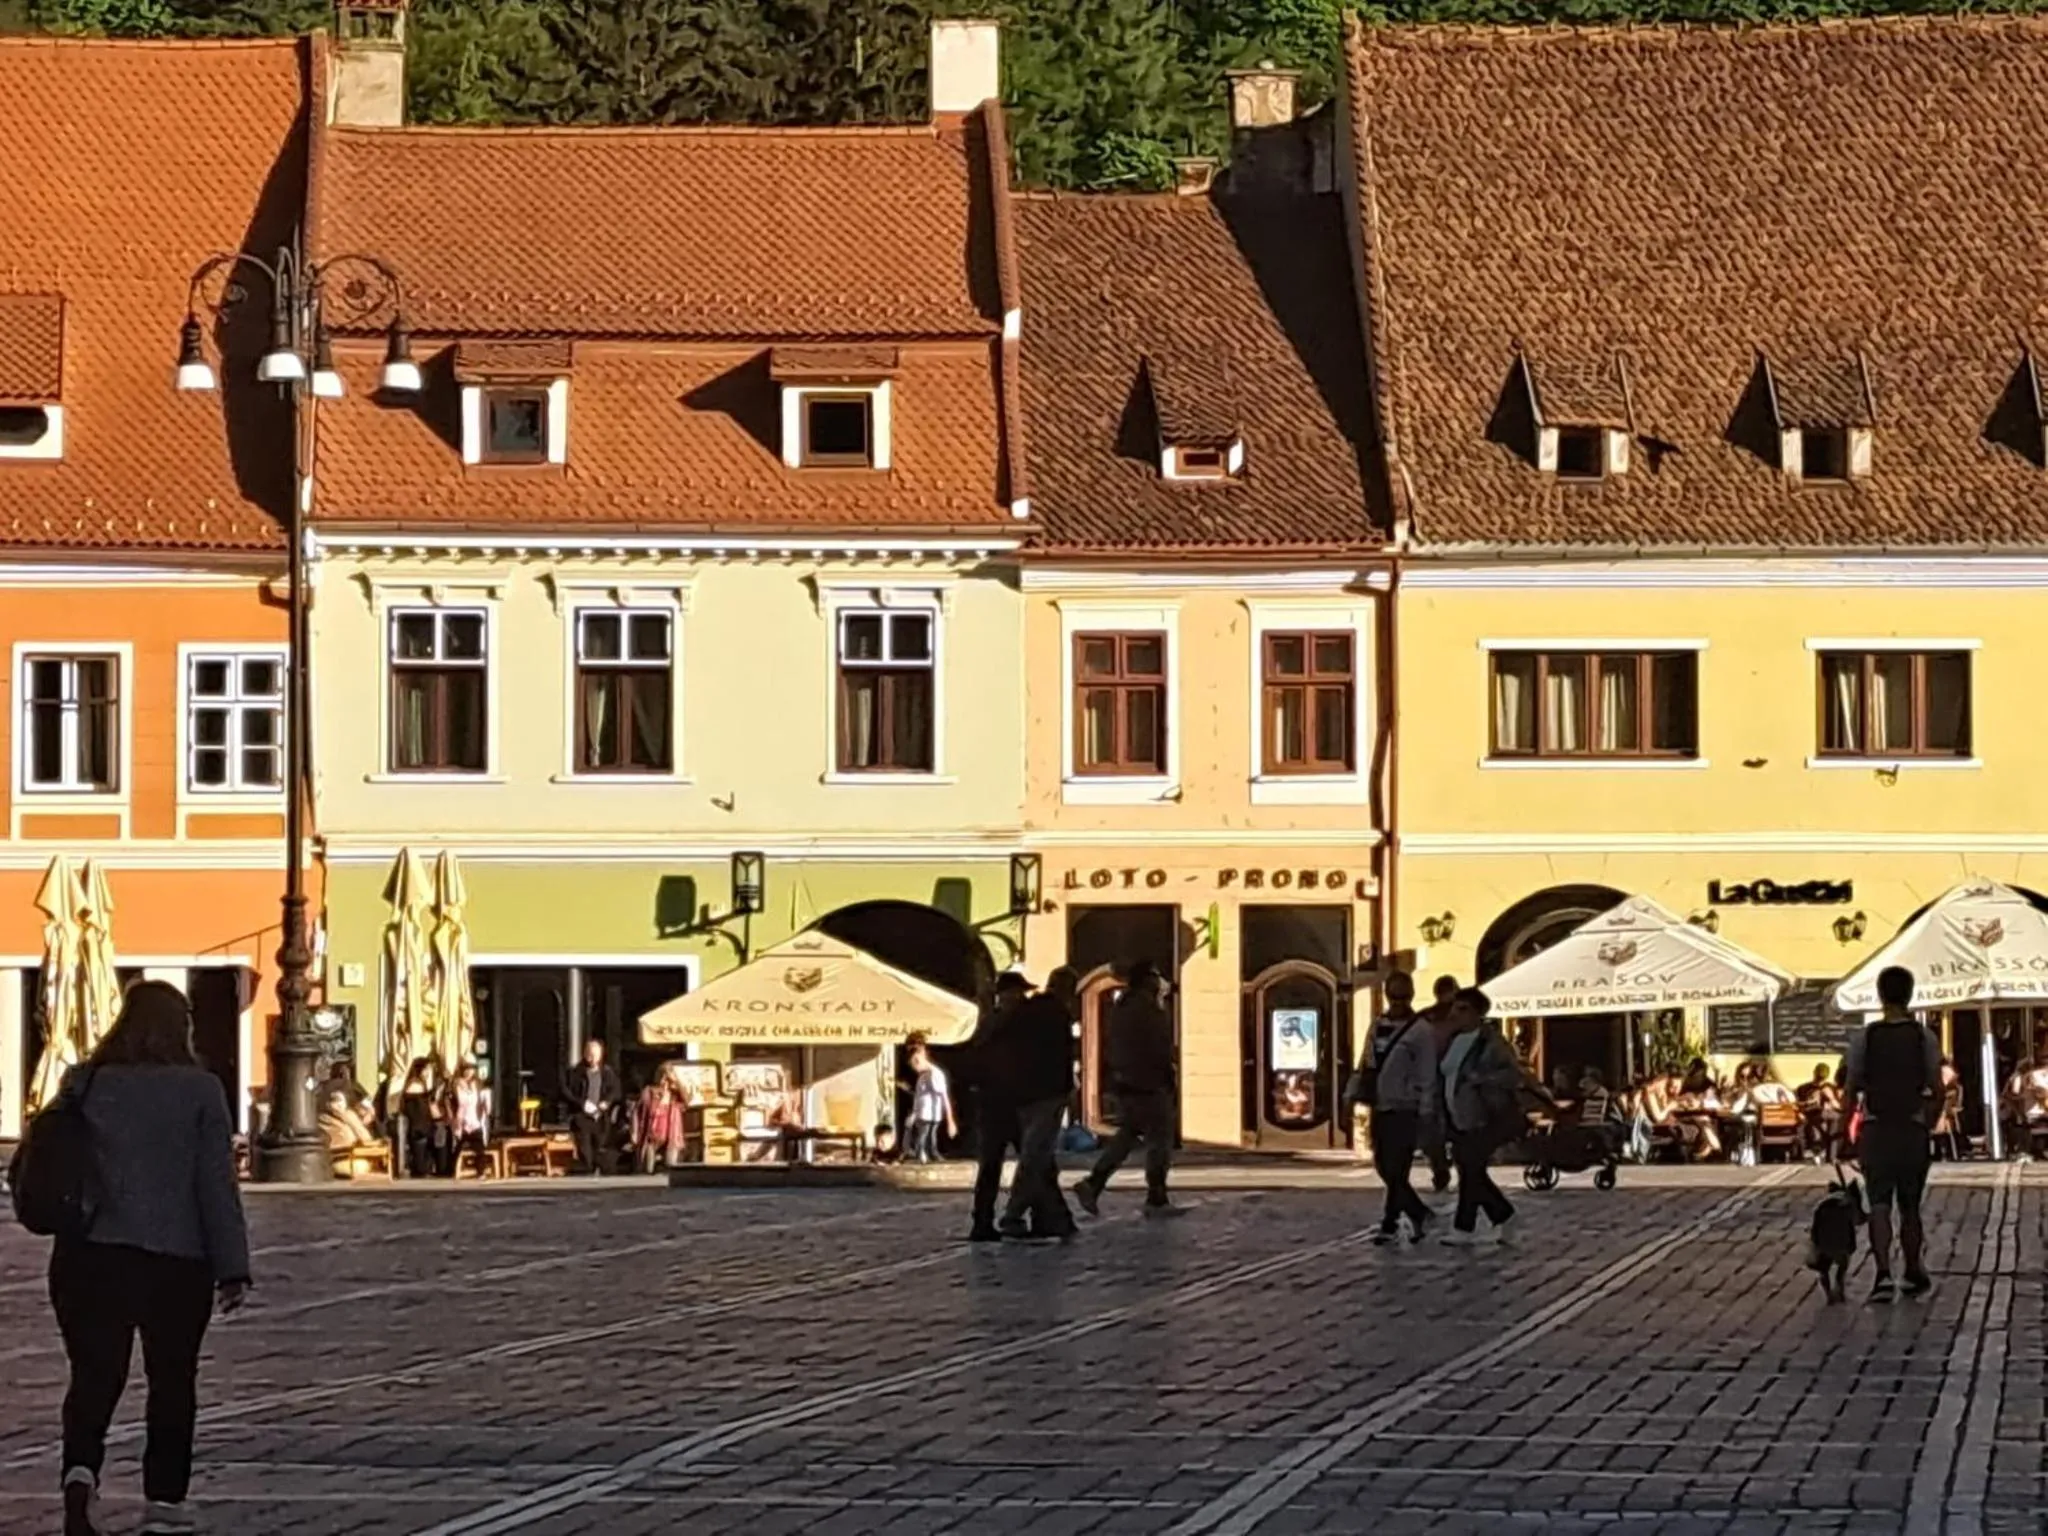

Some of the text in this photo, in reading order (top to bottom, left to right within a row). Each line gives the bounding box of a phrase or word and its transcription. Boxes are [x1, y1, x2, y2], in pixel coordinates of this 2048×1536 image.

[1063, 867, 1168, 890] LOTO
[1216, 867, 1348, 890] PRONO
[702, 998, 896, 1014] KRONSTADT
